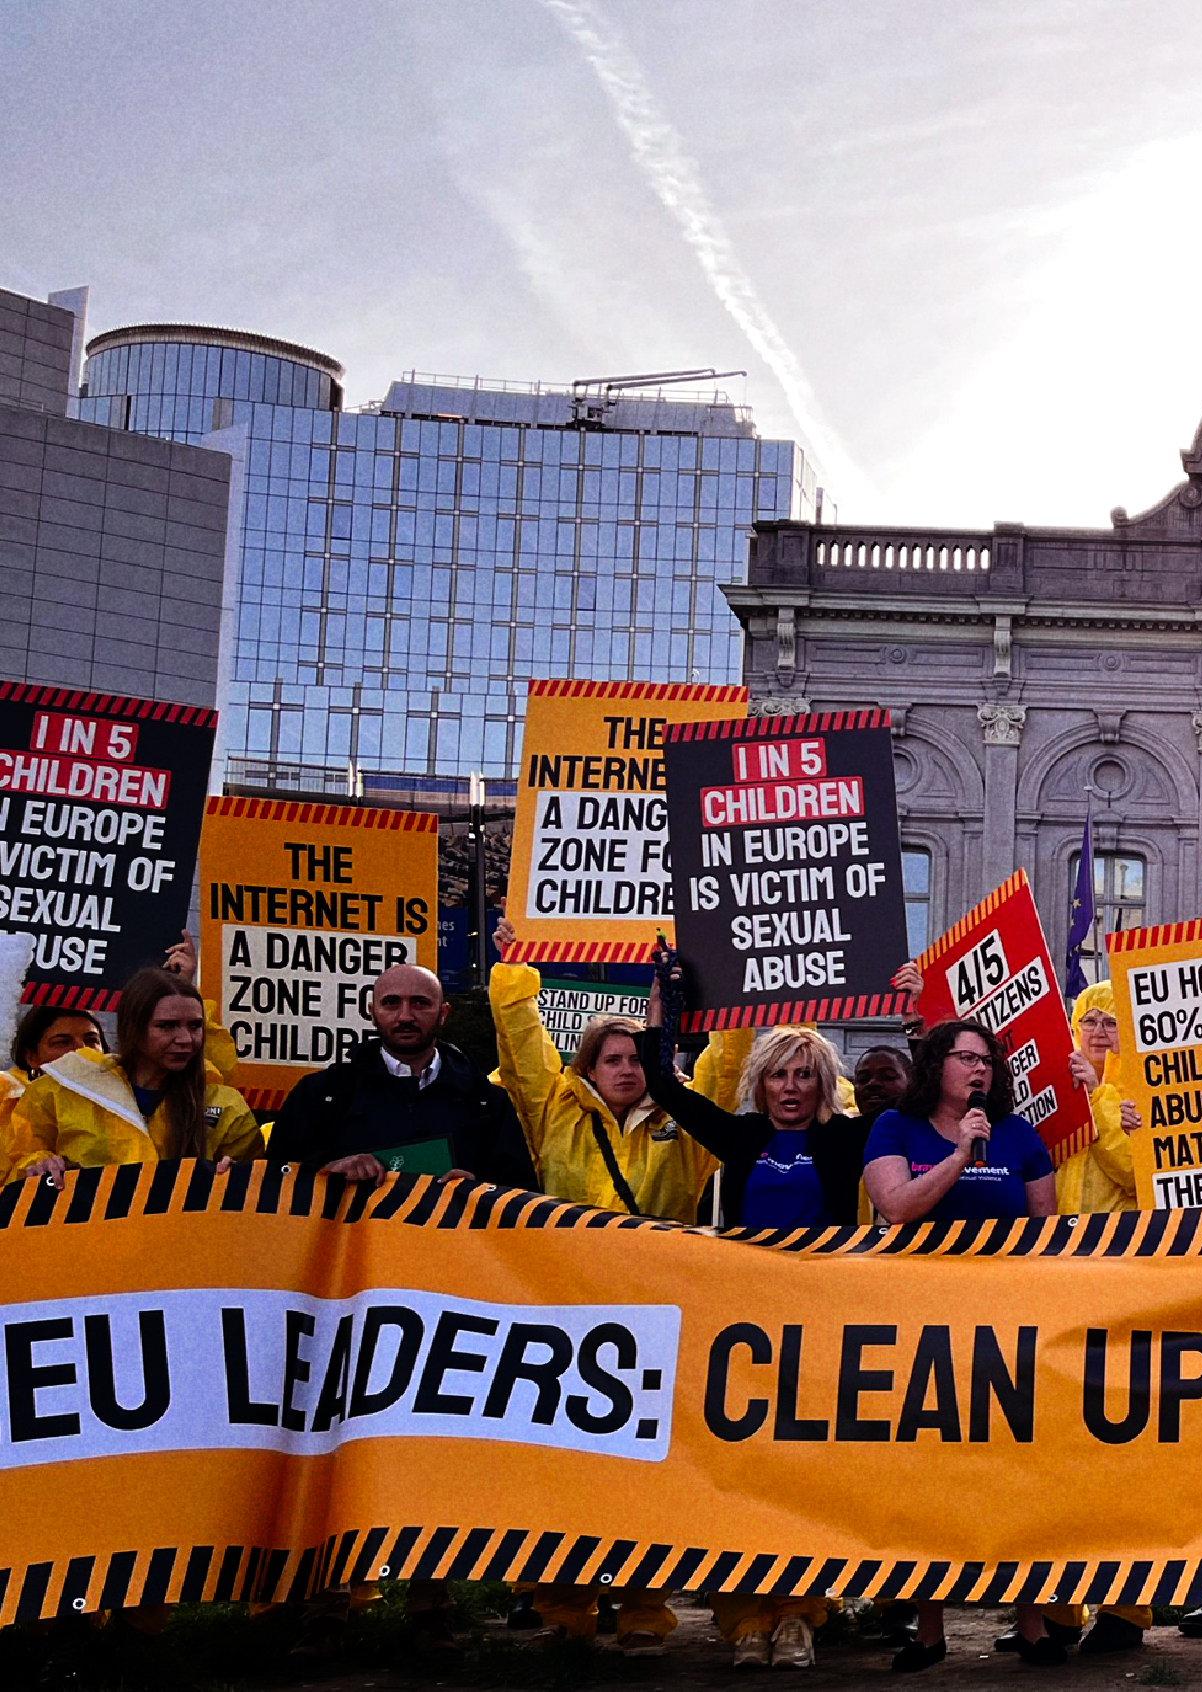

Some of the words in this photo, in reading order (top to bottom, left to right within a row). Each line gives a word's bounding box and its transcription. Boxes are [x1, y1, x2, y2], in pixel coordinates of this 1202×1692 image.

[59, 718, 97, 755] IN
[107, 724, 132, 759] 5
[603, 717, 667, 749] THE
[528, 755, 666, 790] INTERNE
[759, 744, 789, 778] IN
[801, 742, 822, 775] 5
[541, 796, 563, 829] A
[576, 797, 667, 831] DANG
[704, 781, 860, 824] CHILDREN
[21, 801, 166, 850] EUROPE
[702, 832, 732, 867] IN
[743, 822, 869, 863] EUROPE
[0, 840, 116, 888] VICTIM
[127, 856, 176, 893] OF
[284, 842, 353, 883] THE
[538, 838, 628, 872] ZONE
[535, 878, 675, 915] CHILDRE
[690, 875, 720, 910] IS
[730, 866, 835, 906] VICTIM
[846, 862, 886, 898] OF
[211, 883, 383, 931] INTERNET
[396, 897, 428, 935] IS
[731, 908, 852, 950] SEXUAL
[14, 930, 107, 974] USE
[229, 930, 252, 967] A
[266, 932, 407, 976] DANGER
[743, 951, 846, 993] ABUSE
[958, 935, 1003, 1006] 4/5
[229, 975, 321, 1017] ZONE
[336, 983, 374, 1021] FO
[538, 989, 588, 1010] STAND
[595, 994, 614, 1011] UP
[619, 997, 649, 1014] FOR
[970, 966, 1042, 1031] TIZENS
[1134, 970, 1169, 1005] EU
[231, 1020, 379, 1063] CHILDR
[5, 1310, 171, 1443] EU
[222, 1305, 662, 1440] LEADERS:
[704, 1322, 1038, 1443] CLEAN
